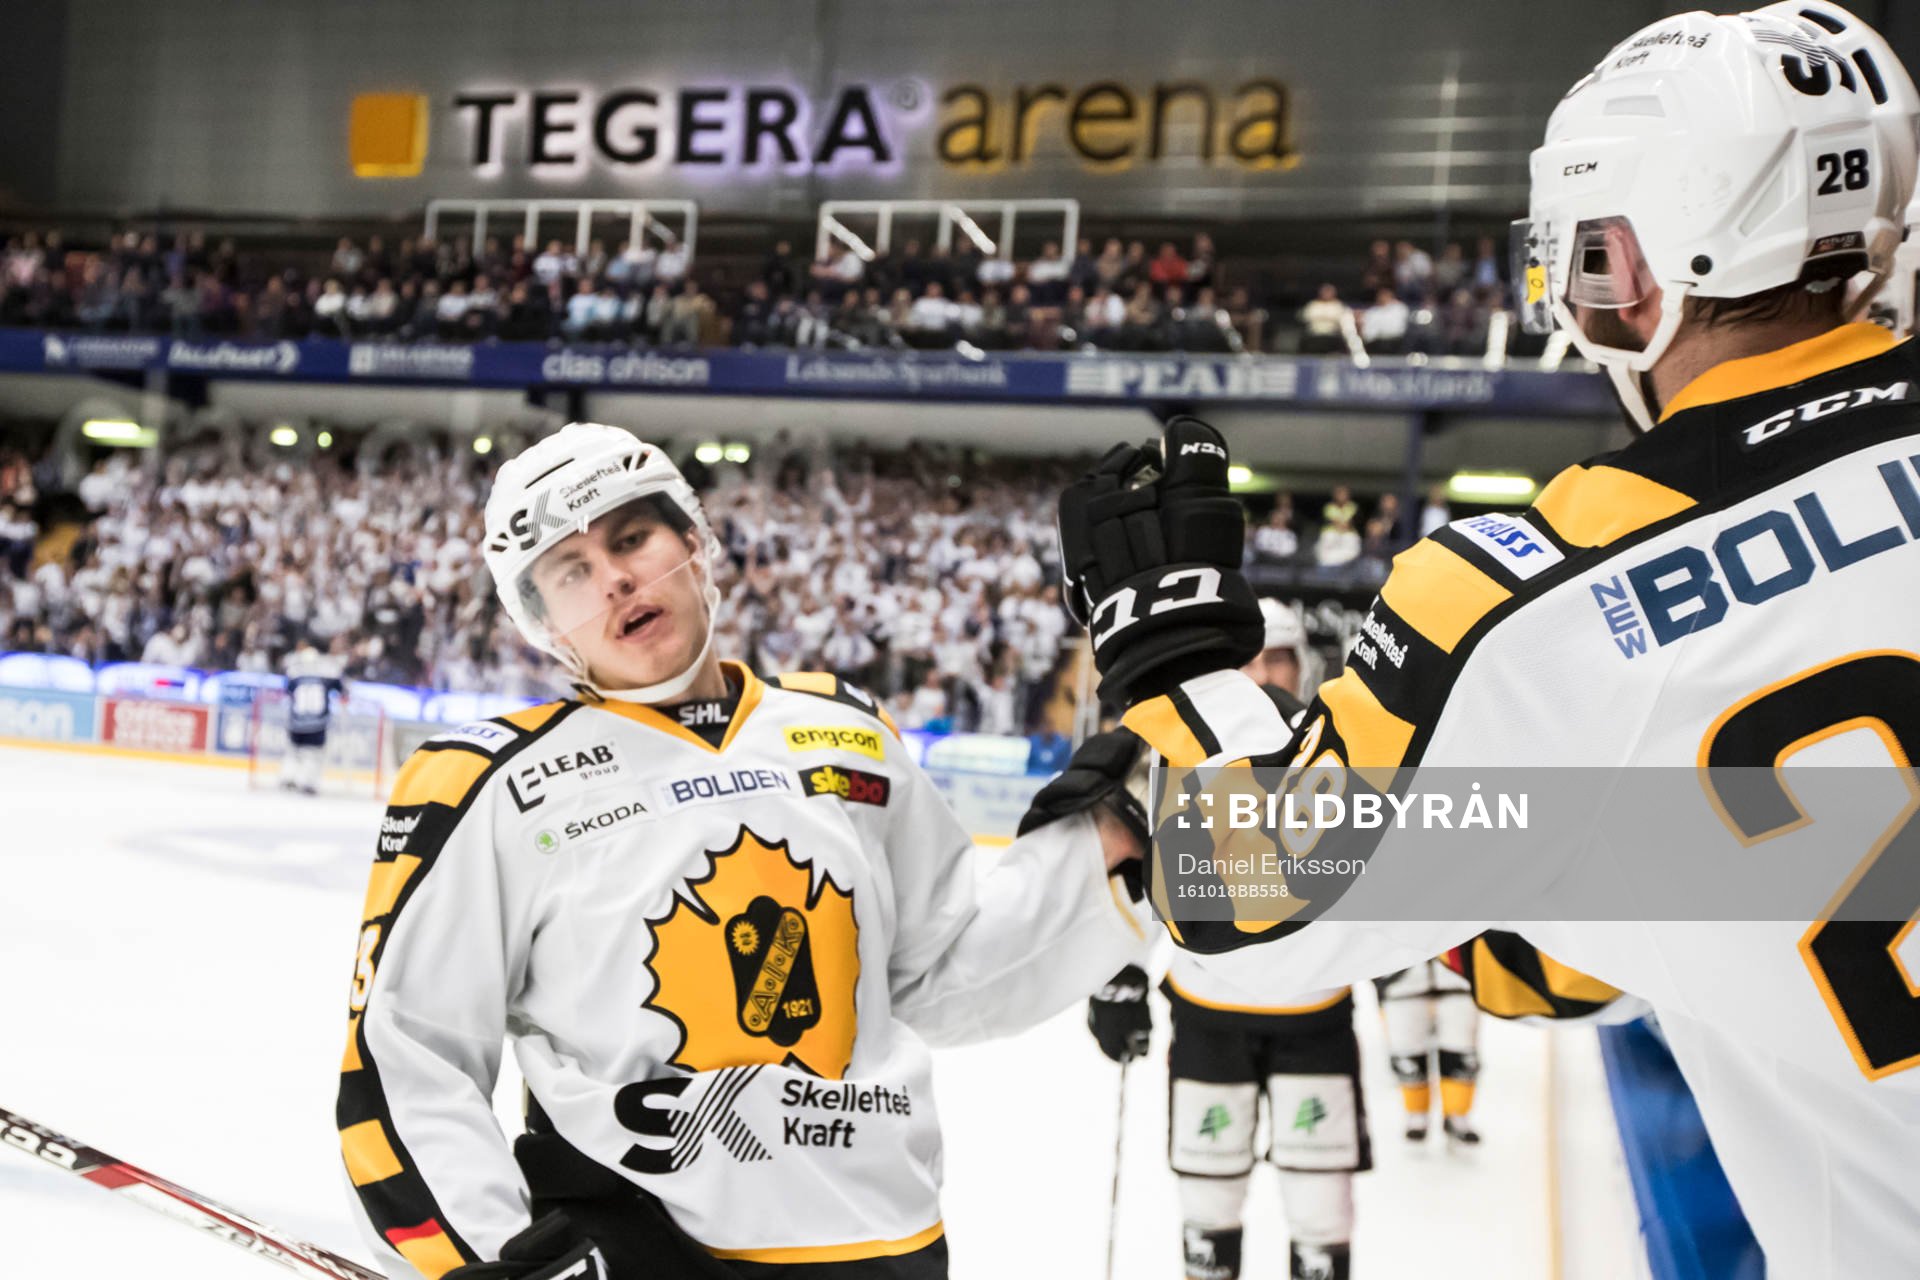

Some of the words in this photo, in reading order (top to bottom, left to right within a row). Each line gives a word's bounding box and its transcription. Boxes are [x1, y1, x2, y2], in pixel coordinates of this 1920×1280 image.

[935, 77, 1300, 168] arena
[1563, 160, 1599, 177] CCM
[1816, 148, 1870, 196] 28
[1741, 382, 1909, 445] CCM
[566, 488, 601, 512] Kraft
[1625, 455, 1920, 648] BOLI
[1590, 575, 1648, 660] NEW
[678, 703, 731, 727] SHL
[790, 729, 879, 751] engcon
[579, 764, 620, 780] group
[671, 769, 792, 804] BOLIDEN
[809, 766, 884, 803] skebo
[564, 801, 648, 840] ŠKODA
[782, 998, 814, 1019] 1921
[781, 1079, 911, 1116] Skellefteå
[783, 1116, 856, 1148] Kraft
